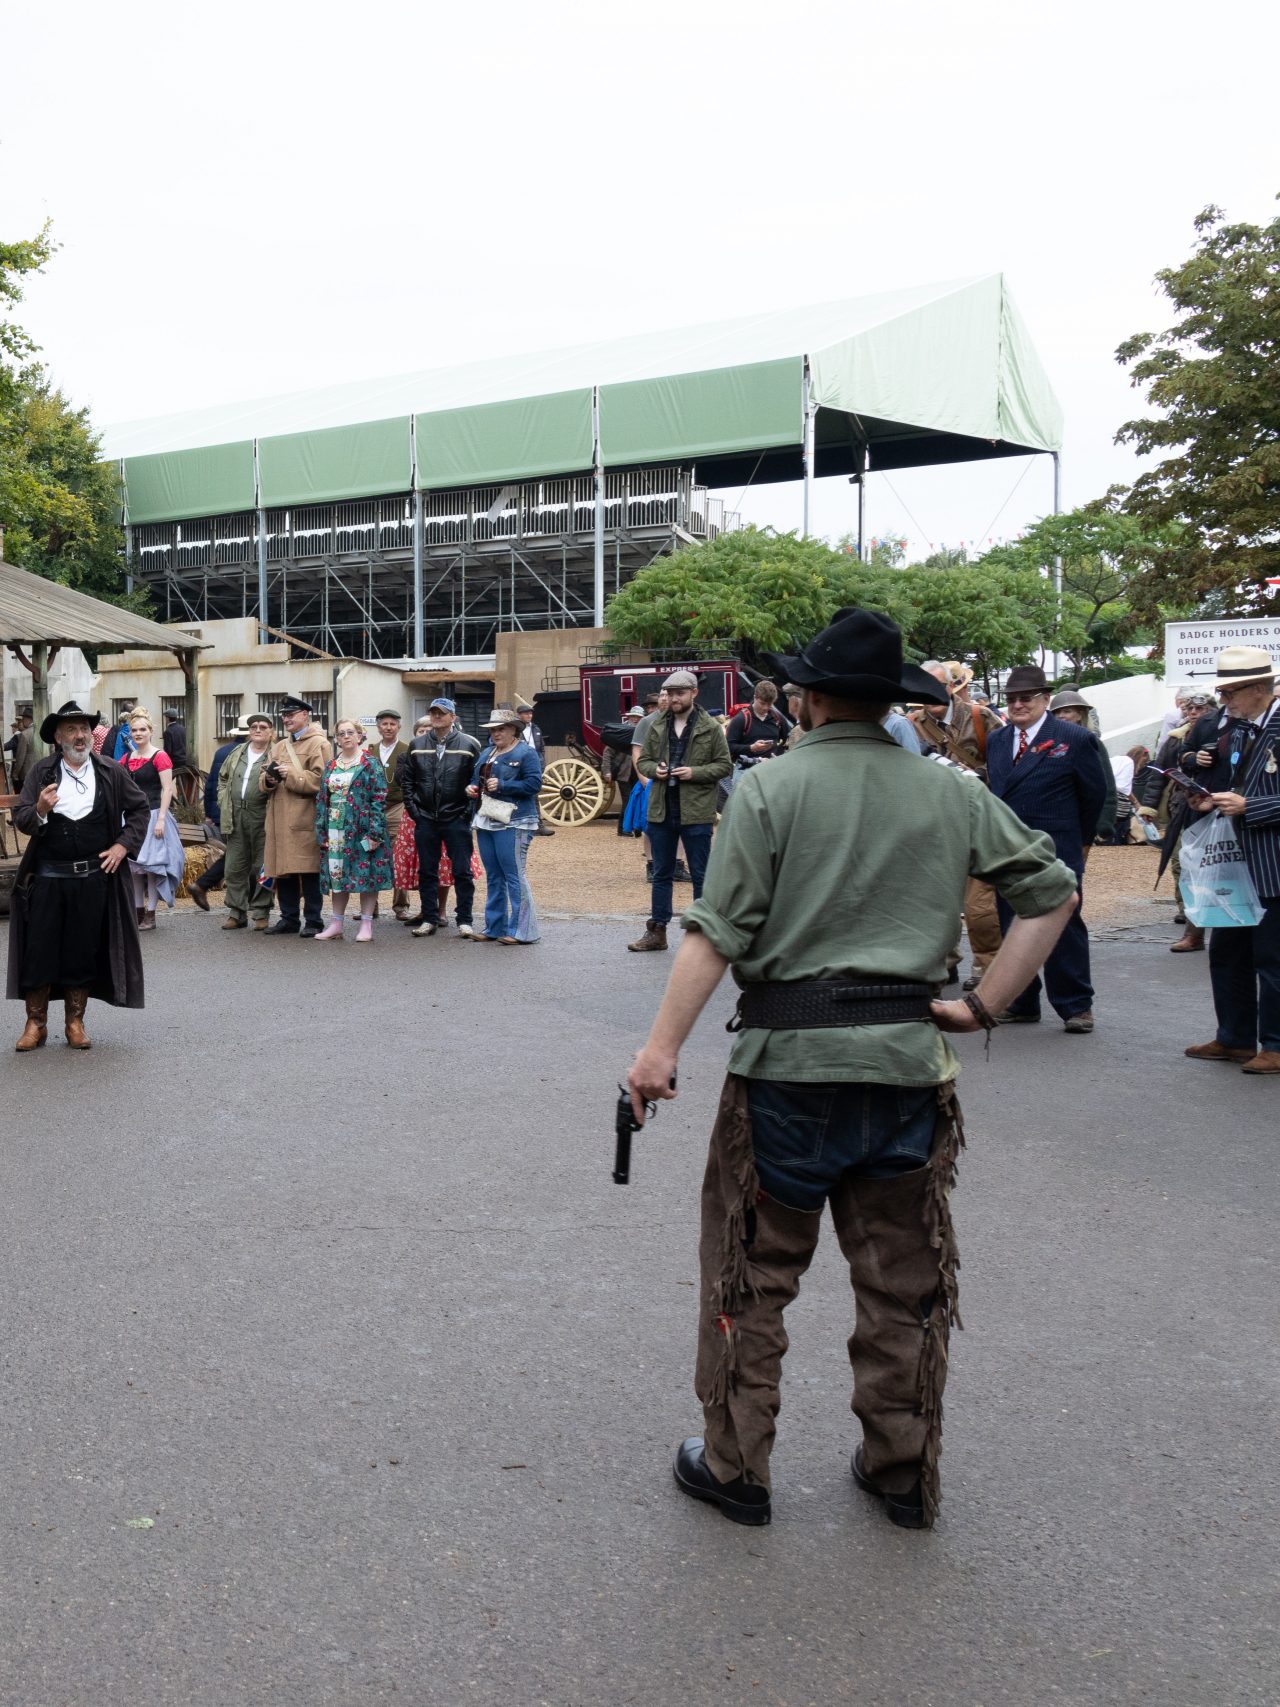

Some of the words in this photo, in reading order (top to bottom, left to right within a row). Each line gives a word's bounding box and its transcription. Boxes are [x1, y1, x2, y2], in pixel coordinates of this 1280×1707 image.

[1180, 630, 1215, 640] BADGE
[1219, 627, 1269, 638] HOLDERS
[1177, 646, 1209, 655] OTHER
[1178, 657, 1214, 666] BRIDGE
